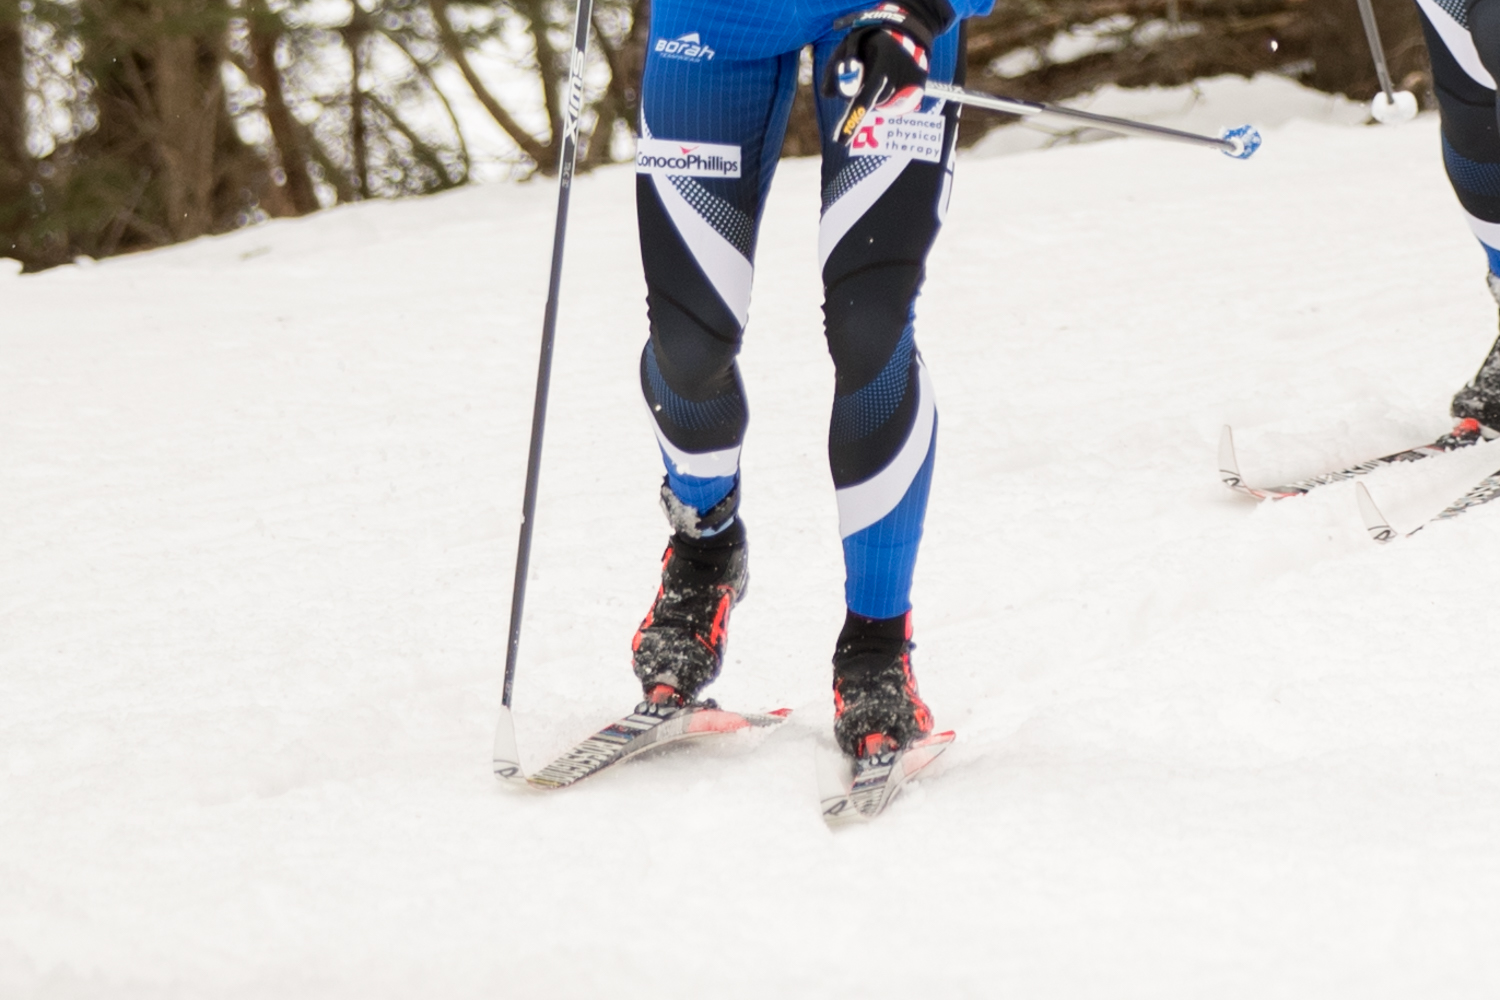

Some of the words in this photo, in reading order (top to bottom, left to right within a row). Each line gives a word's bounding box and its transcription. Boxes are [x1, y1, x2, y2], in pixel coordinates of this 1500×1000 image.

[565, 47, 585, 146] SWIX
[842, 106, 867, 136] TOKO
[888, 115, 943, 130] advanced
[887, 127, 941, 143] physical
[885, 140, 940, 158] therapy
[637, 151, 739, 176] ConocoPhillips
